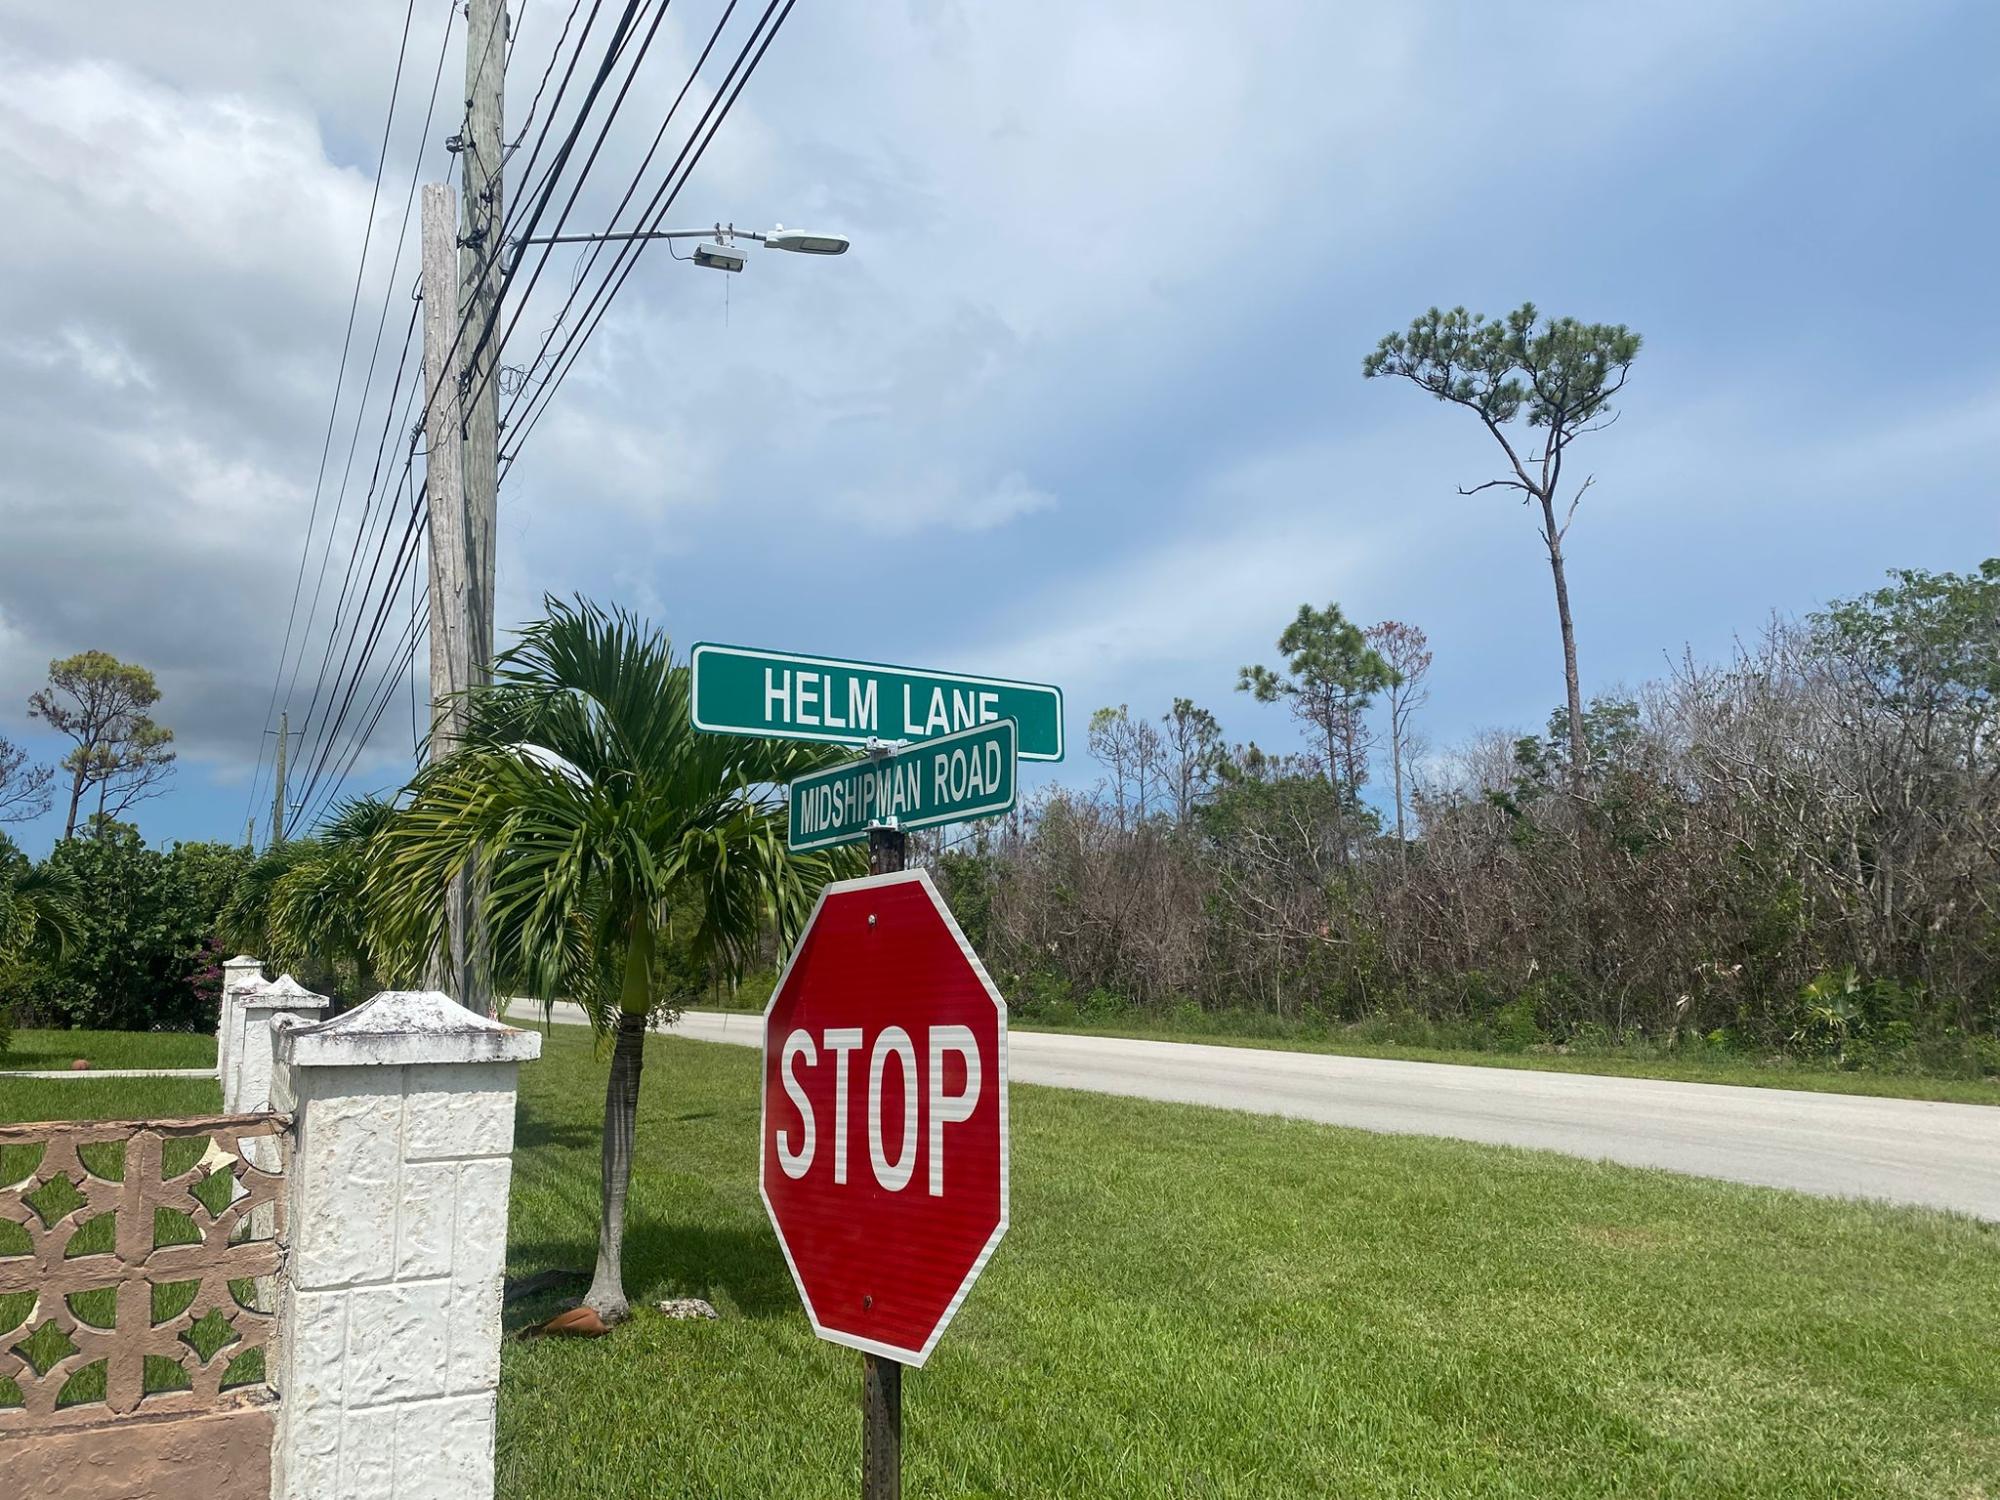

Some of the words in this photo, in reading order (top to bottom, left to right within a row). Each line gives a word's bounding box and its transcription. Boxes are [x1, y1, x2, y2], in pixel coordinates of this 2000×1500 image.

[765, 667, 878, 731] HELM
[903, 683, 999, 736] LANE
[800, 760, 921, 835] MIDSHIPMAN
[934, 740, 1001, 806] ROAD
[776, 1025, 982, 1197] STOP
